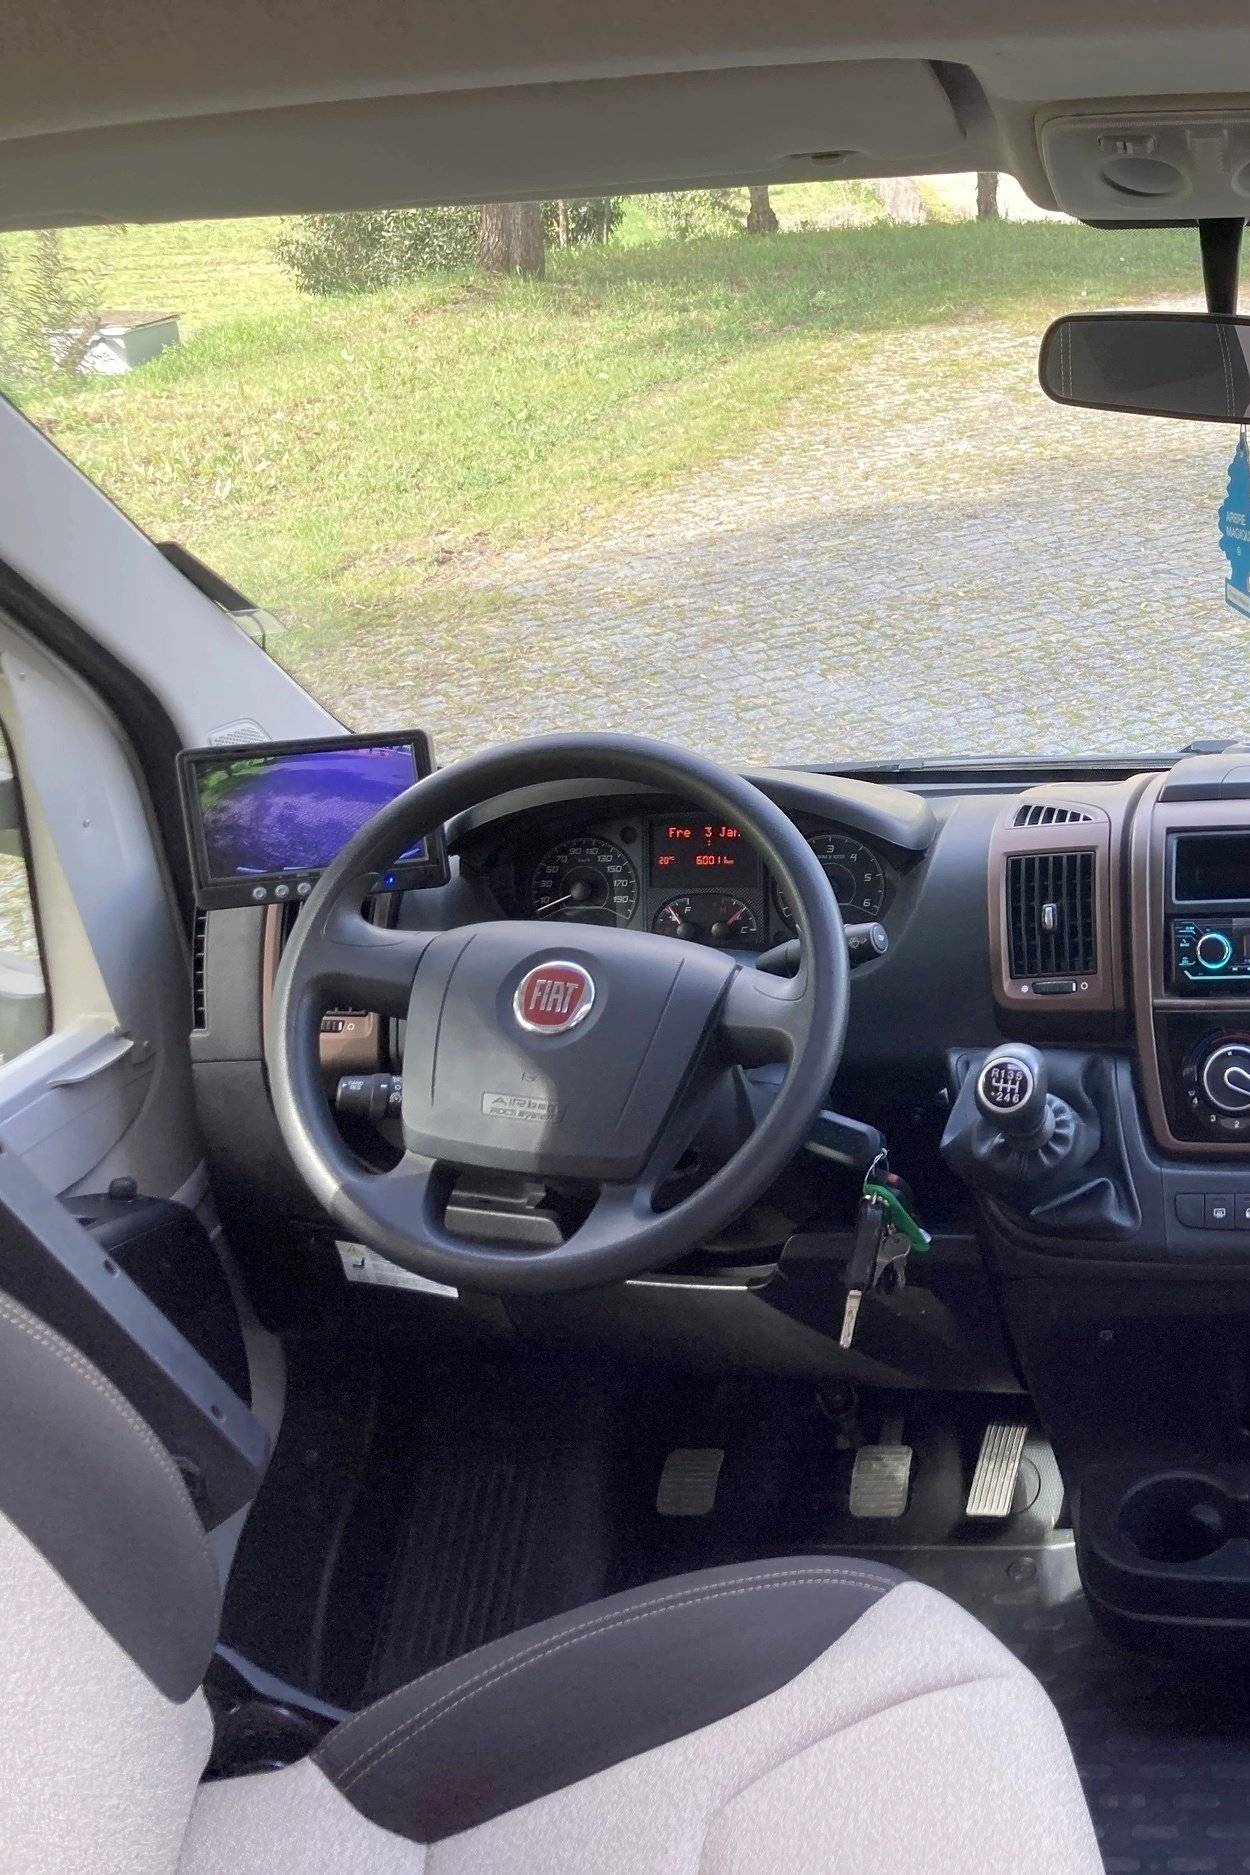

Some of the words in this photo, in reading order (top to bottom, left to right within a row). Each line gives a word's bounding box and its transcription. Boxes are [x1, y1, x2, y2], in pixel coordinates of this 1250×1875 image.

[668, 827, 691, 838] Fre
[705, 827, 713, 838] 3
[826, 844, 835, 853] 3
[597, 854, 613, 862] 130
[850, 853, 858, 861] 4
[607, 865, 622, 873] 150
[864, 873, 872, 882] 5
[613, 879, 628, 887] 170
[863, 898, 871, 907] 6
[684, 906, 692, 914] F
[529, 979, 580, 1014] FIAT
